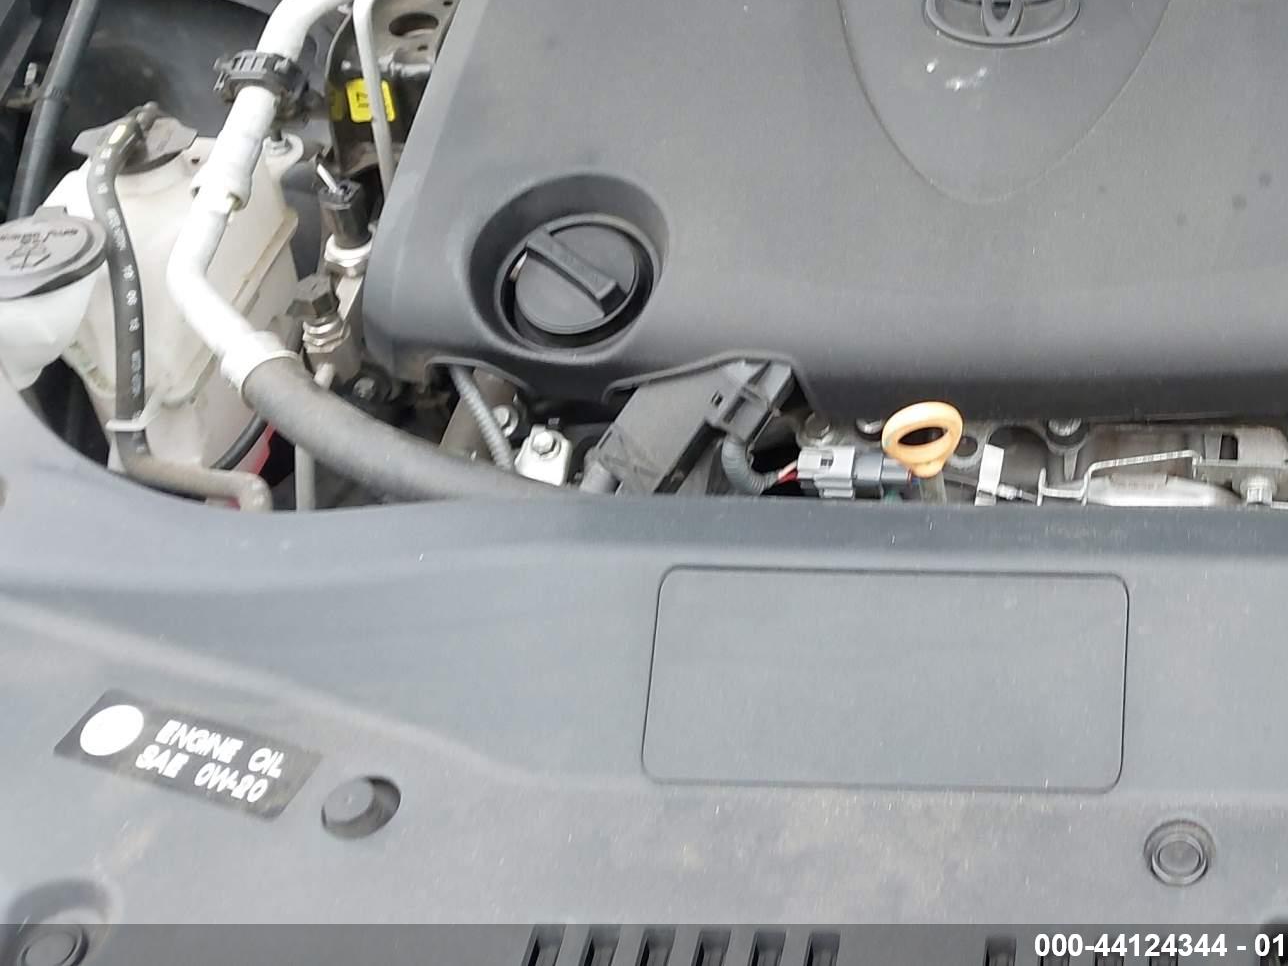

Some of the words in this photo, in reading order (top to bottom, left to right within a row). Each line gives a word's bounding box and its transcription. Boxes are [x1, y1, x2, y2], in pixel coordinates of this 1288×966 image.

[135, 744, 190, 779] SAE
[194, 762, 269, 803] 0W-20
[155, 719, 244, 764] ENGINE
[248, 747, 285, 779] OIL
